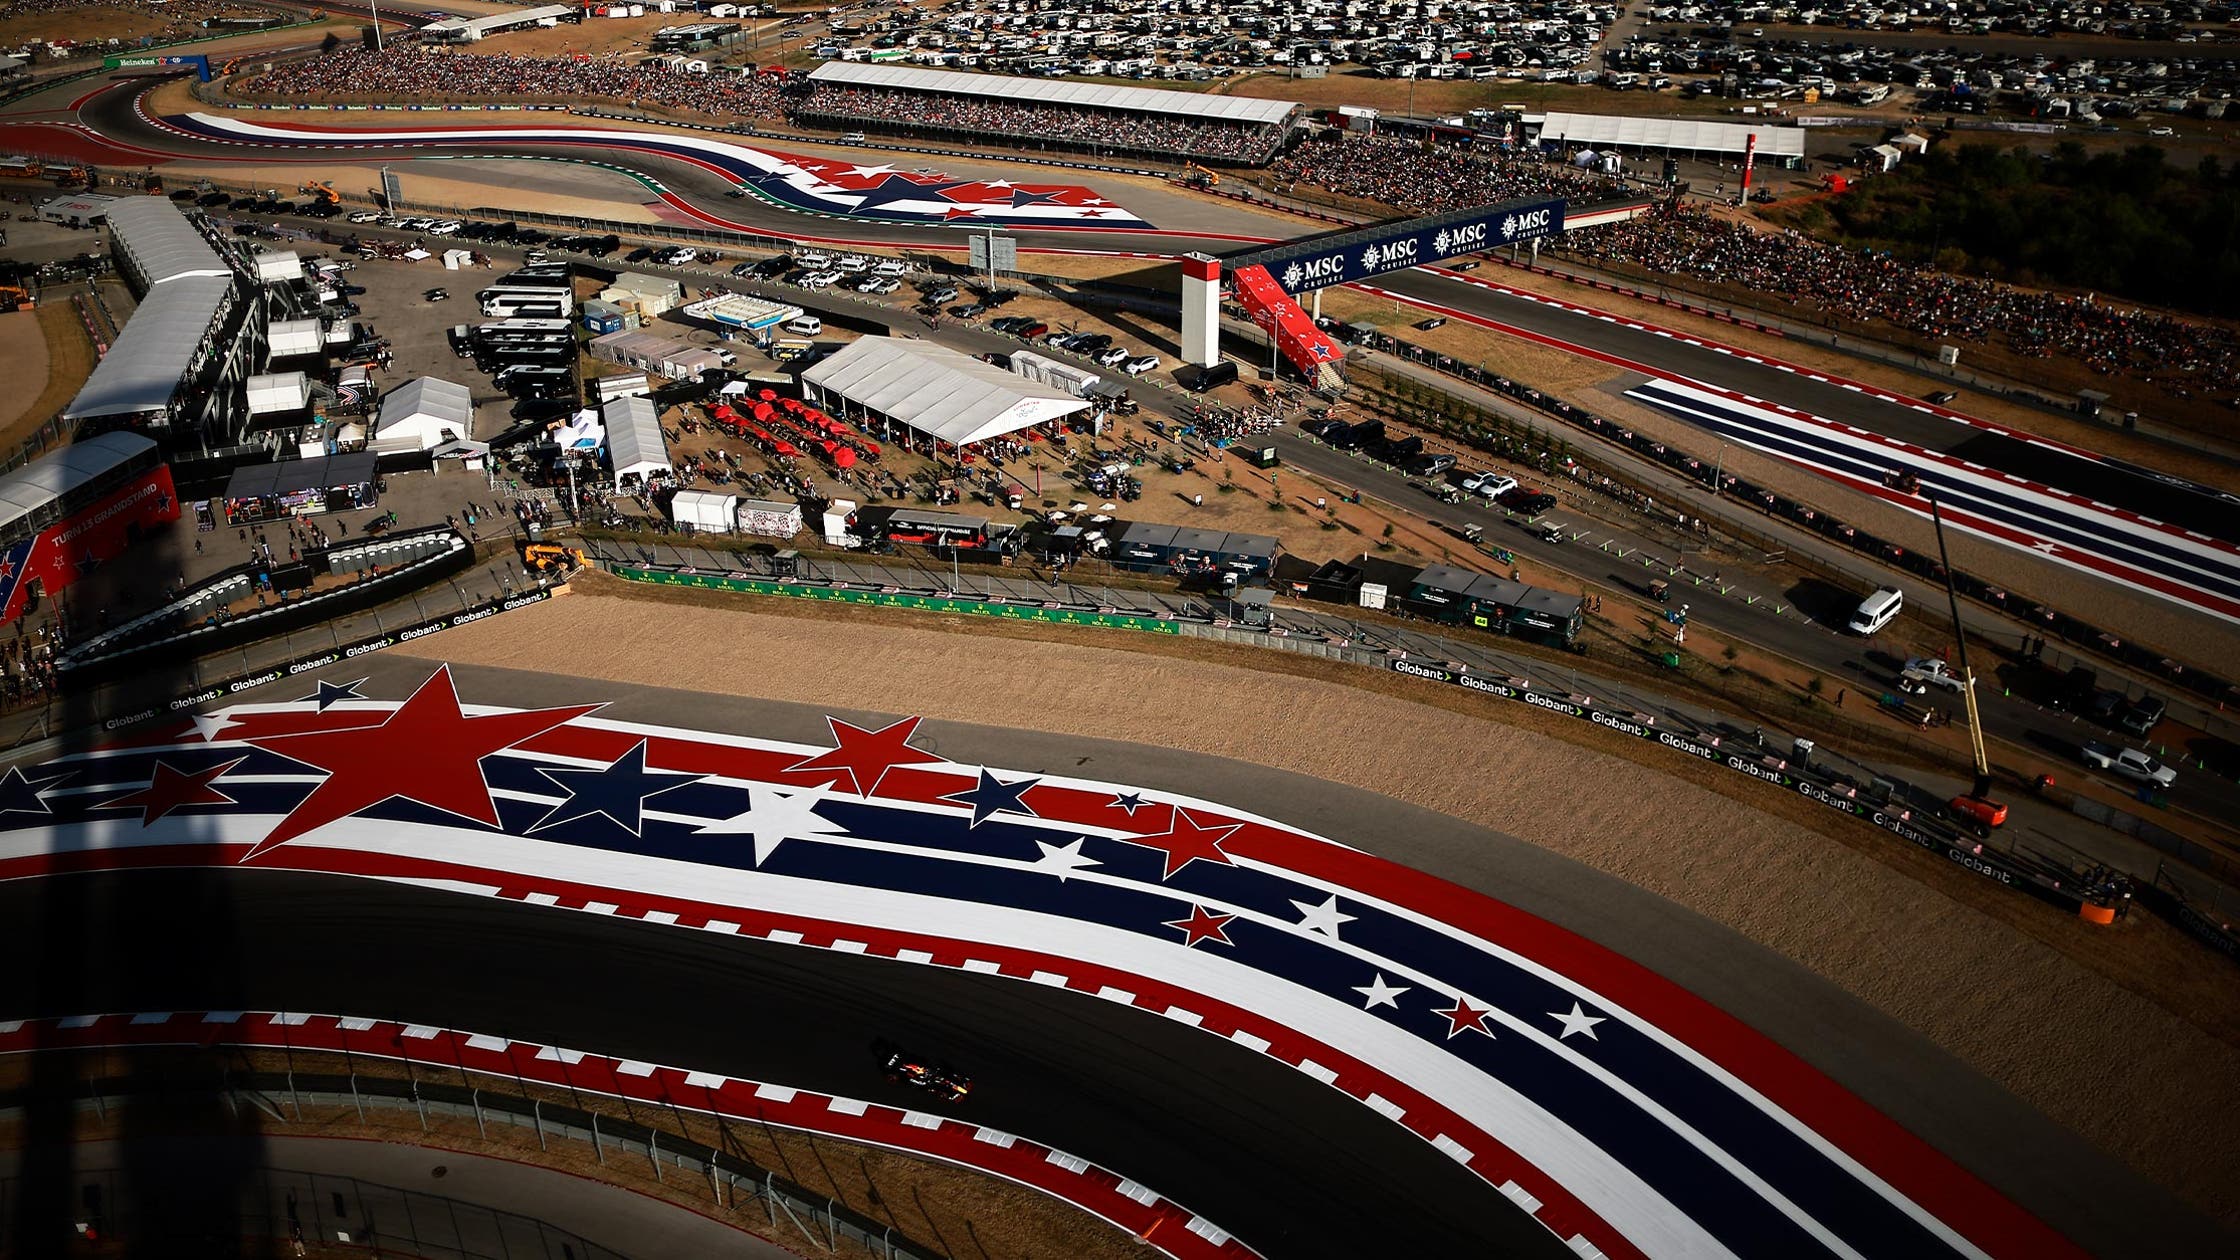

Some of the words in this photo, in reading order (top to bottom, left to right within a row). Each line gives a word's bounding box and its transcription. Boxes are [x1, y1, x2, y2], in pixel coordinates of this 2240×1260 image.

[120, 58, 156, 66] Heineken
[1518, 209, 1550, 231] MSC
[1452, 223, 1486, 246] MSC
[1517, 227, 1549, 239] CRUISES
[1382, 238, 1418, 262] MSC
[1451, 241, 1485, 254] CRUISES
[1304, 254, 1344, 279] MSC
[1381, 257, 1417, 271] CRUISES
[1304, 274, 1344, 289] CRUISES
[51, 526, 81, 547] TURN
[82, 519, 94, 531] 13
[94, 483, 157, 525] GRANDSTAND
[504, 593, 542, 610] Globant
[453, 608, 492, 625] Globant
[400, 623, 441, 641] Globant
[346, 639, 388, 657] Globant
[289, 655, 333, 674] Globant
[1395, 661, 1443, 681] Globant
[230, 673, 276, 692] Globant
[1460, 675, 1509, 696] Globant
[170, 691, 216, 710] Globant
[1525, 692, 1574, 715] Globant
[1592, 711, 1642, 736] Globant
[1660, 732, 1711, 759] Globant
[1728, 756, 1781, 784] Globant
[1799, 782, 1853, 812] Globant
[1873, 812, 1929, 846] Globant
[1949, 849, 2011, 884] Globant
